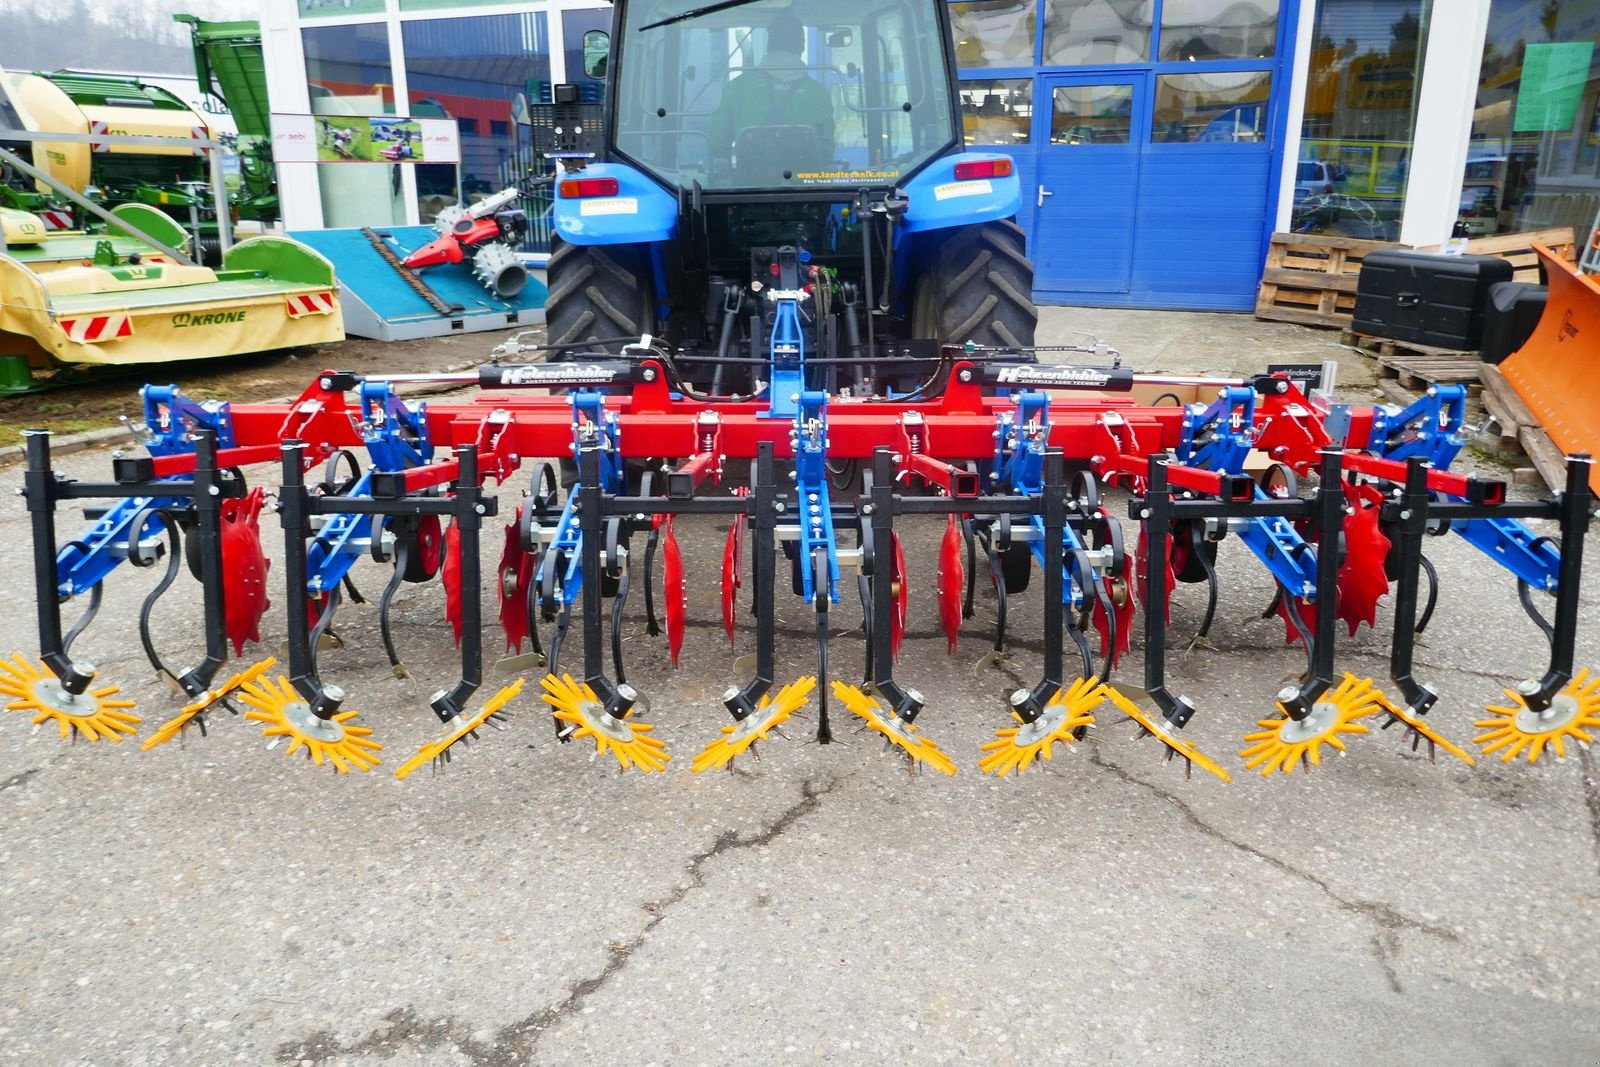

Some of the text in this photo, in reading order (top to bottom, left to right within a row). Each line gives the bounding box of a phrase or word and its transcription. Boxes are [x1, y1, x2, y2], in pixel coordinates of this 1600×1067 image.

[797, 171, 899, 179] www.landtechnik.co.at
[191, 311, 246, 326] KRONE
[501, 366, 617, 384] Hatzenbichler
[997, 367, 1112, 384] Hatzenbichler
